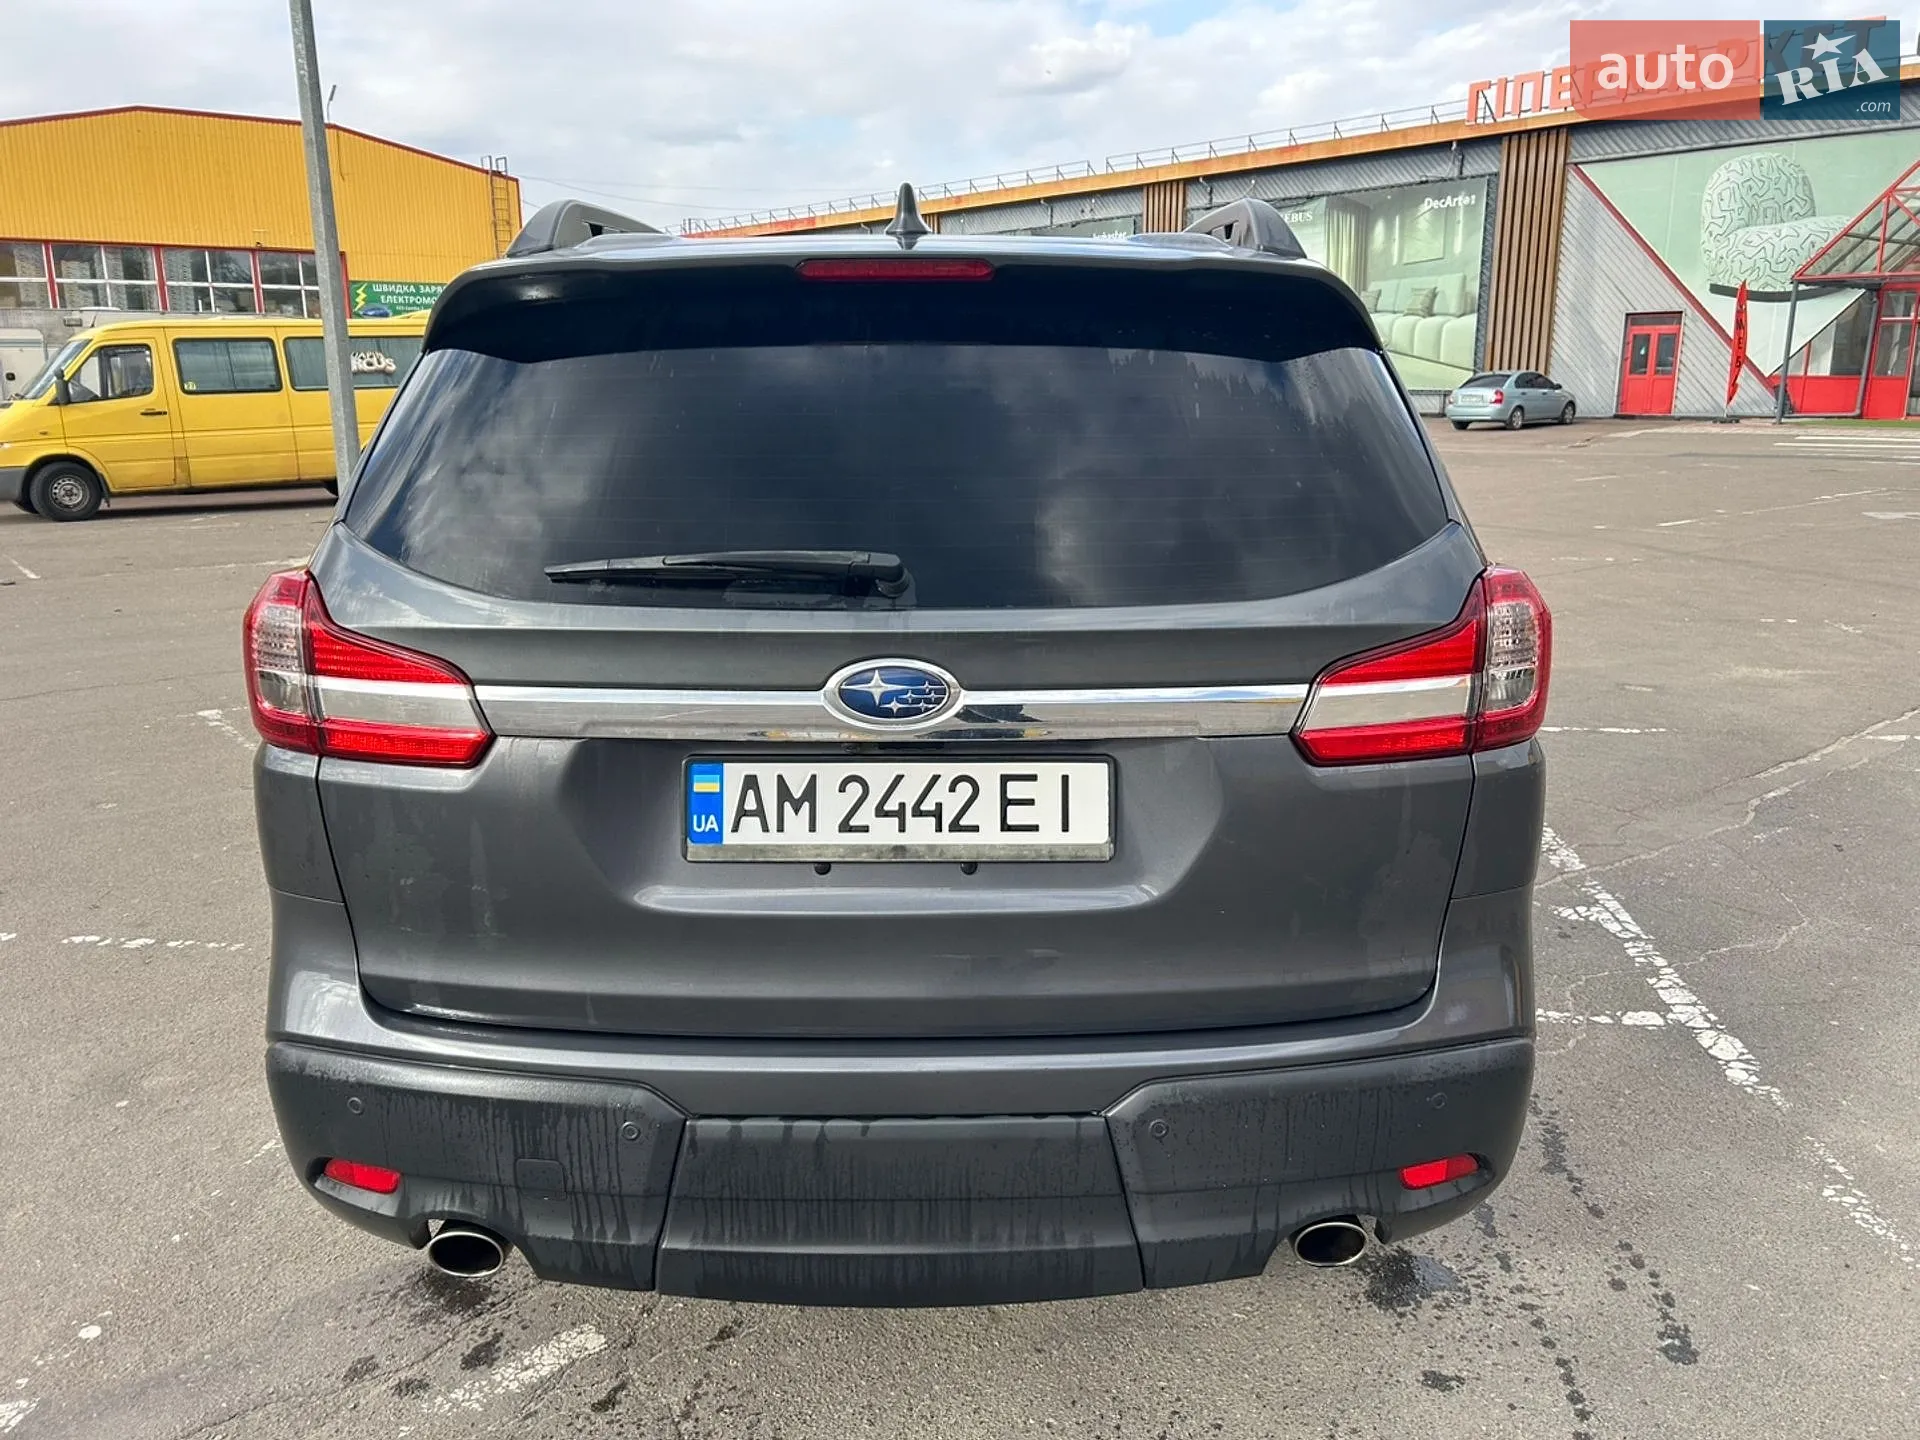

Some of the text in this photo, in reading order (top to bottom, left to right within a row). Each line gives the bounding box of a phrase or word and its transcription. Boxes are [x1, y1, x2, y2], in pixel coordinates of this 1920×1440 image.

[373, 283, 416, 294] ШВИДКА
[730, 774, 1070, 834] AM 2442 EI
[693, 814, 719, 833] UA
